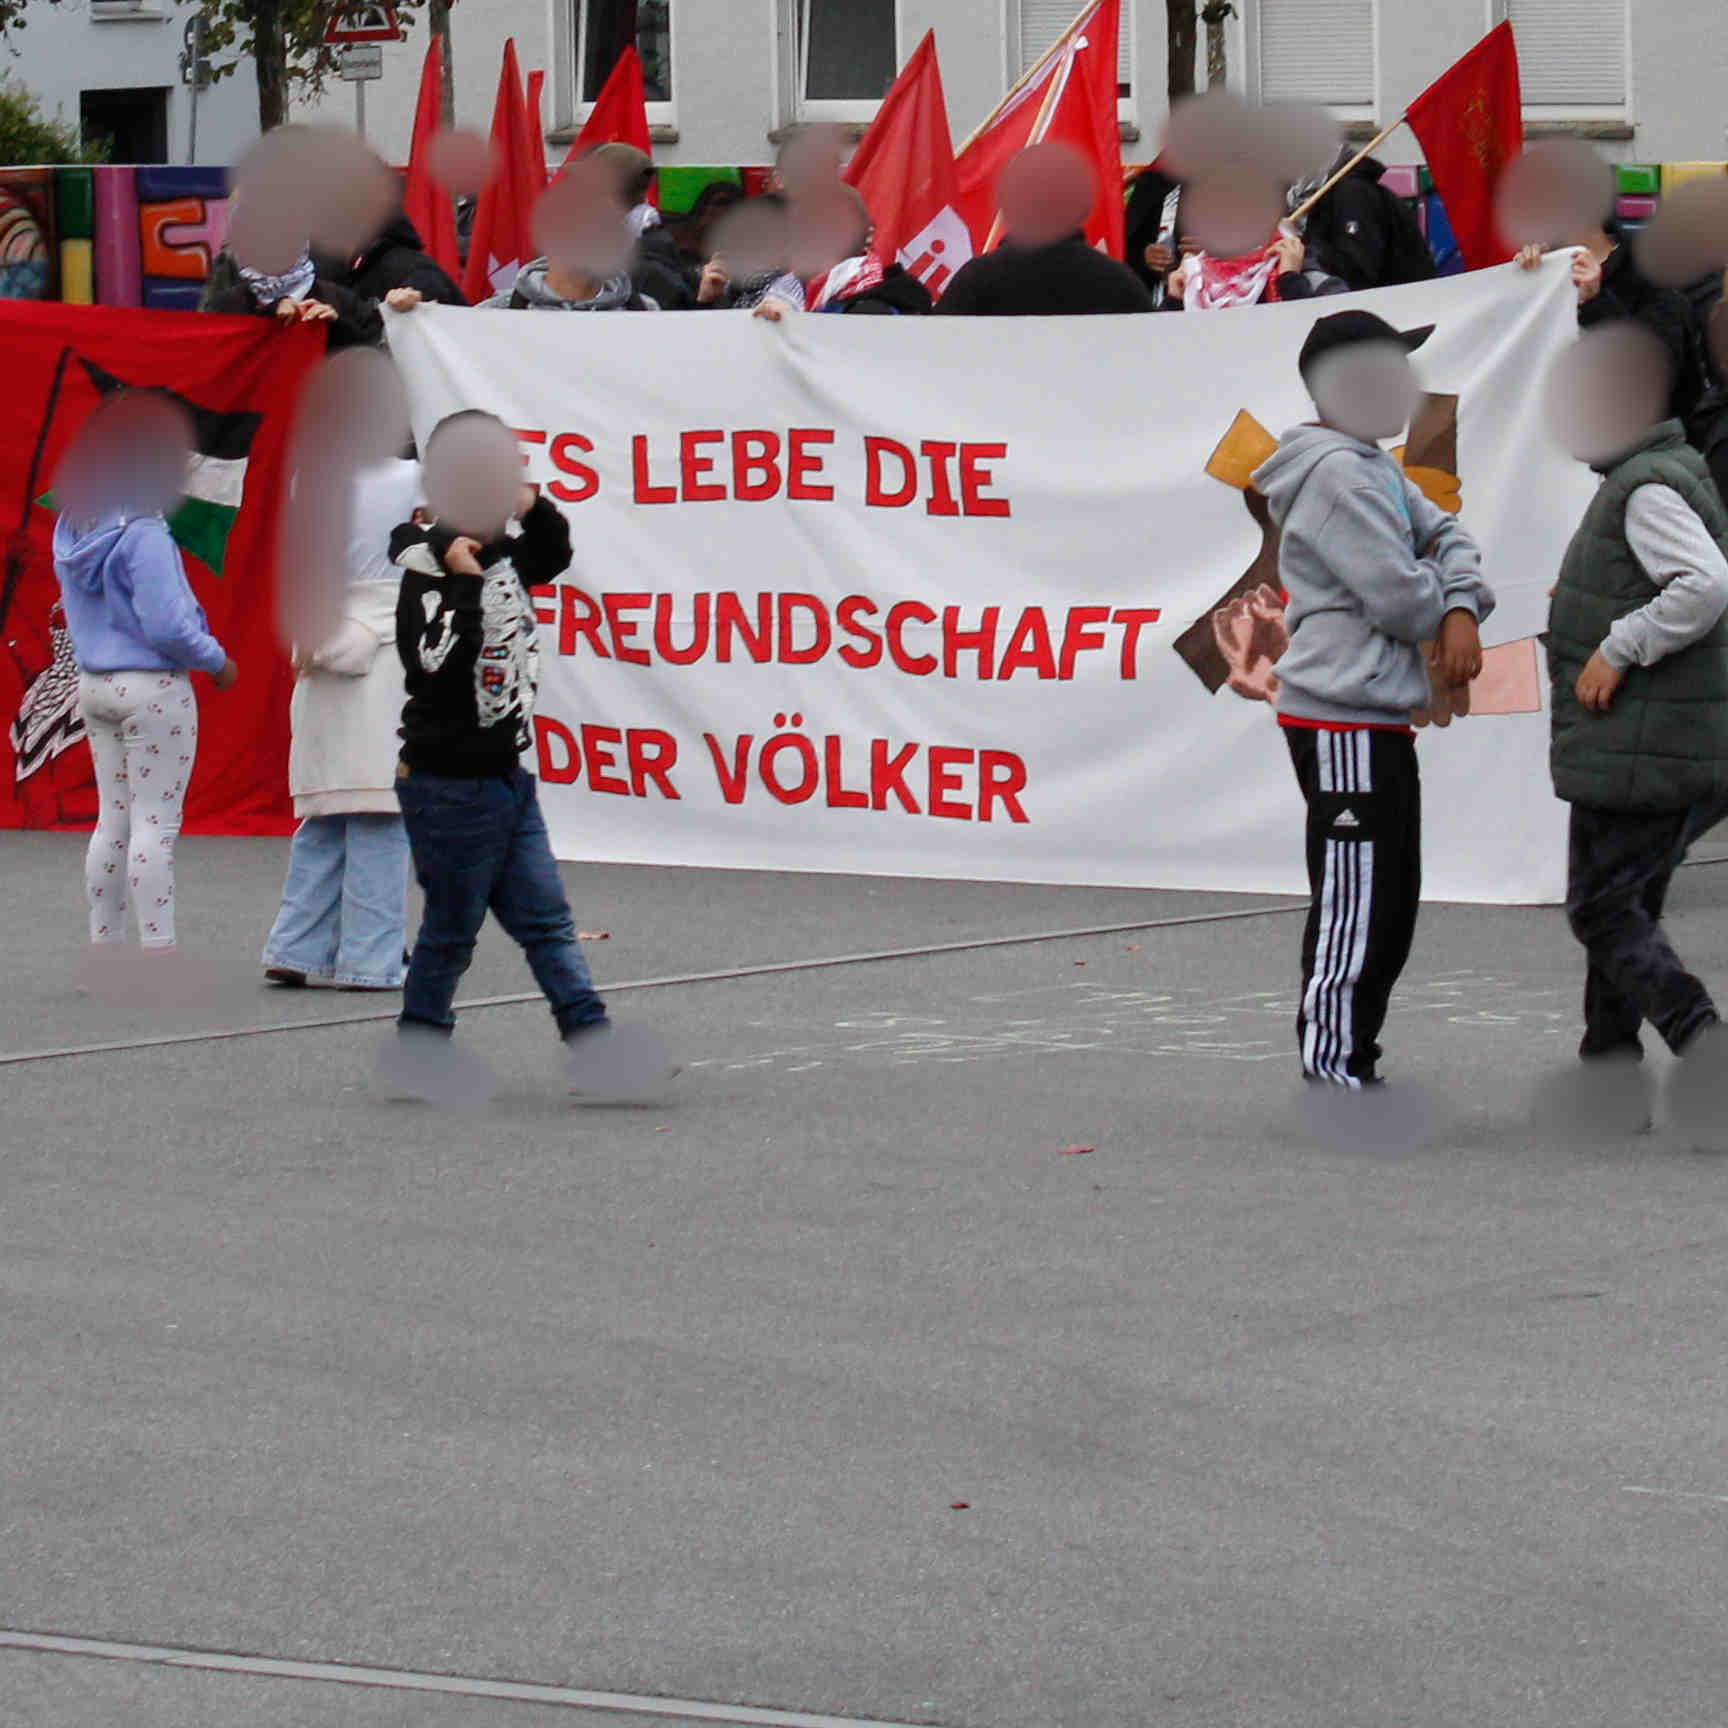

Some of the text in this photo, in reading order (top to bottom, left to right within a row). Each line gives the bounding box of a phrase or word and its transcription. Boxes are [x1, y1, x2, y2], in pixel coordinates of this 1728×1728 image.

[632, 428, 834, 505] LEBE
[865, 436, 1011, 518] DIE
[532, 712, 1030, 823] DER VÖLKER
